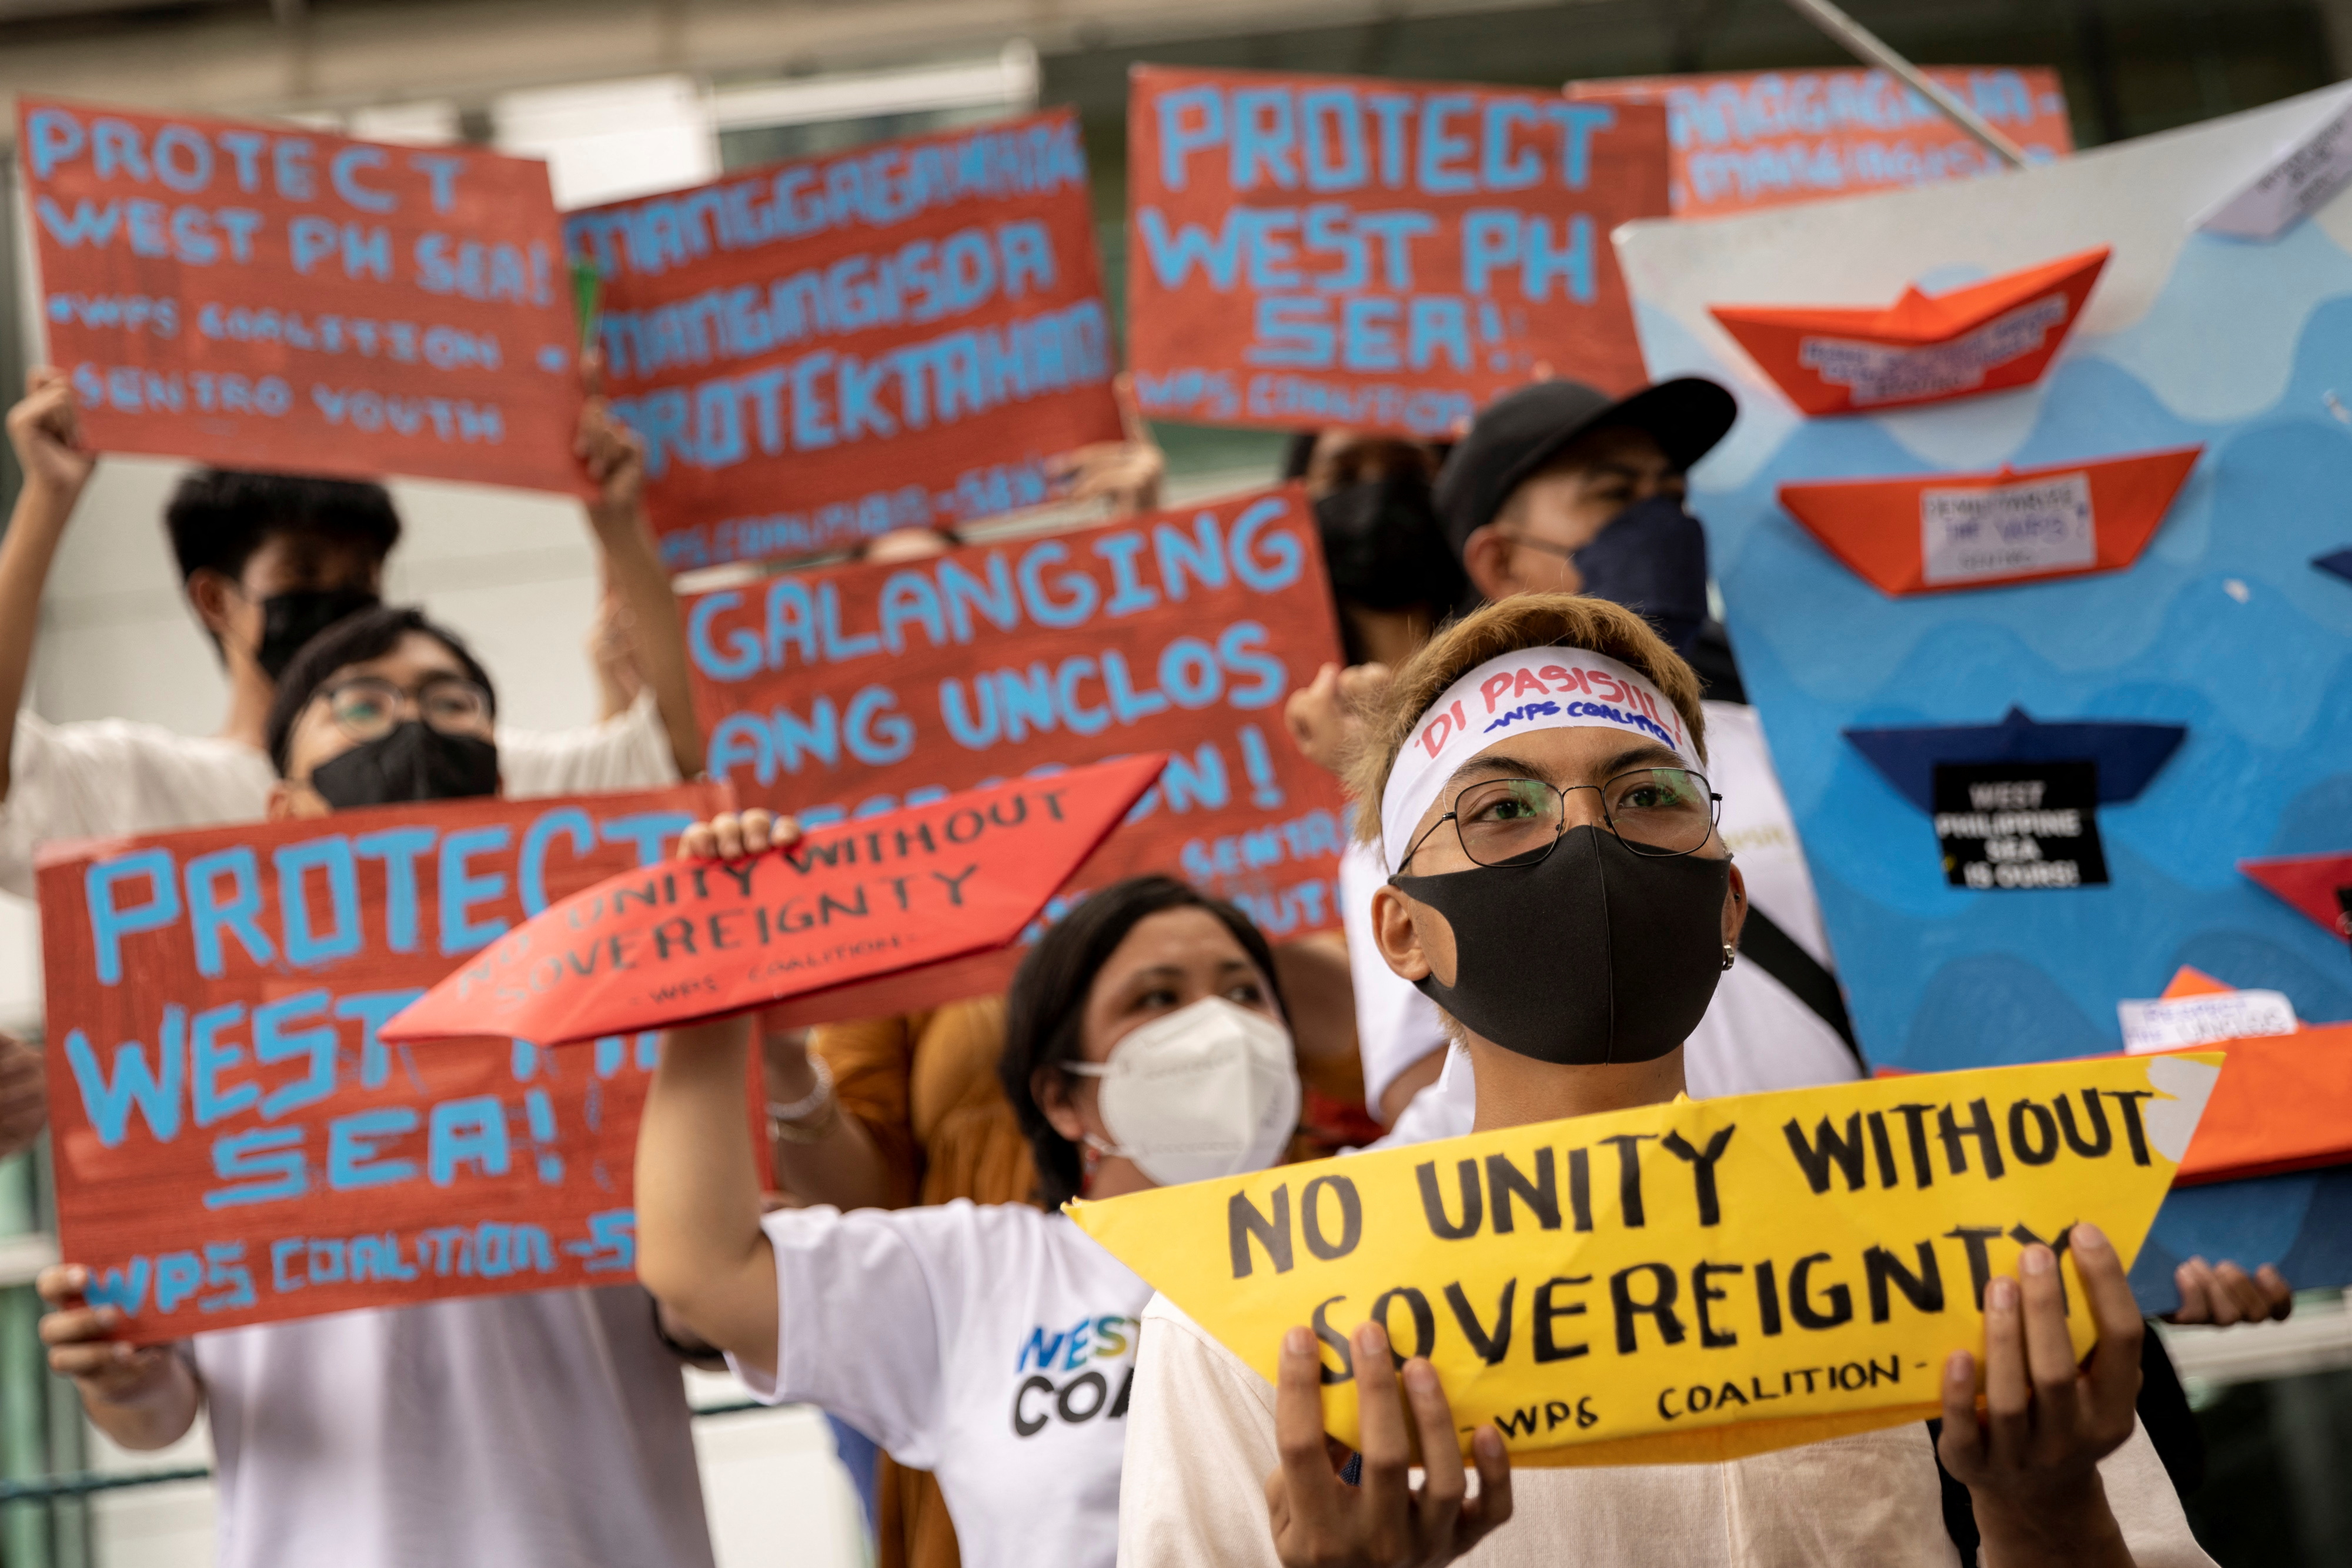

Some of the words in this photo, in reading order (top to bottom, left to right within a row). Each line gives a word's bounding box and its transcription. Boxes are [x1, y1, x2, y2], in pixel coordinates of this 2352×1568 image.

[26, 108, 465, 213] PROTECT
[1155, 85, 1615, 193] PROTECT
[36, 195, 263, 265] WEST
[289, 215, 393, 281] PH
[413, 232, 554, 307] SEA!
[1138, 203, 1436, 292] WEST
[1463, 209, 1596, 303] PH
[1243, 294, 1512, 373] SEA!
[72, 362, 292, 416] SENTRO
[312, 383, 505, 444] YOUTH
[1135, 369, 1238, 417] WPS
[687, 495, 1304, 683] GALANGING
[708, 685, 916, 787] ANG
[940, 621, 1289, 750] UNCLOS
[1935, 809, 2082, 840] PHILIPPINE
[1969, 780, 2046, 811] WEST
[1984, 835, 2043, 863] SEA
[85, 807, 699, 985] PROTECT
[568, 858, 760, 931] UNITY
[783, 790, 1067, 874] WITHOUT
[1963, 860, 1994, 889] IS
[1994, 860, 2082, 889] OURS!
[495, 862, 978, 1010] SOVEREIGNTY
[63, 987, 433, 1146] WEST
[203, 1088, 563, 1209] SEA!
[1228, 1175, 1362, 1279] NO
[1415, 1123, 1736, 1241] UNITY
[1783, 1088, 2153, 1195] WITHOUT
[84, 1242, 255, 1317] WPS
[269, 1221, 559, 1292] COALITION
[1311, 1219, 2079, 1385] SOVEREIGNTY
